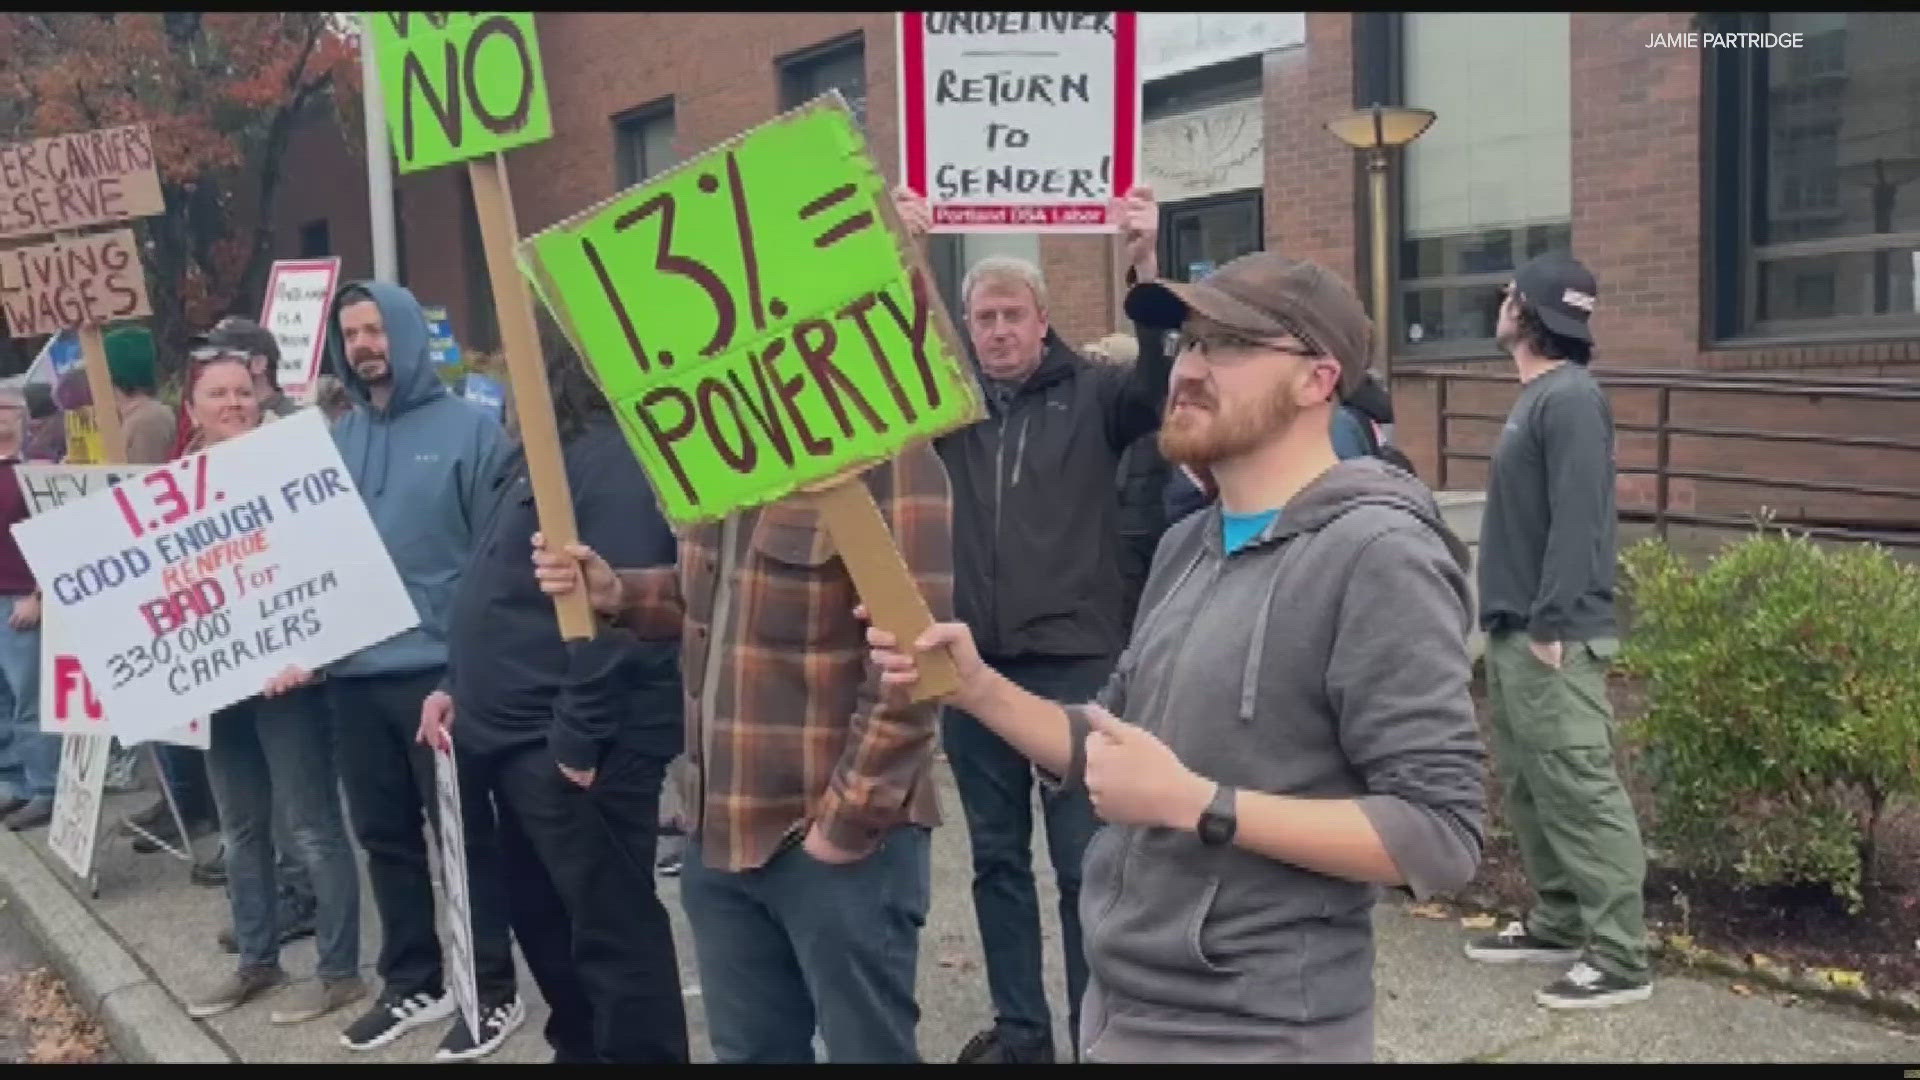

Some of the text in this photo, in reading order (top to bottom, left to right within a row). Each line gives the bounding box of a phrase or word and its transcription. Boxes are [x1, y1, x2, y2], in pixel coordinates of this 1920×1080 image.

[403, 16, 533, 162] NO
[936, 69, 1089, 106] RETURN
[936, 156, 1110, 198] SENDER!
[7, 273, 137, 333] WAGES
[582, 151, 788, 374] 1.3%
[636, 269, 941, 506] POVERTY
[53, 467, 350, 606] GOOD ENOUGH FOR
[113, 455, 225, 538] 1.3%
[139, 564, 280, 639] BAD for
[259, 571, 338, 619] LETTER
[168, 608, 322, 694] CARRIERS
